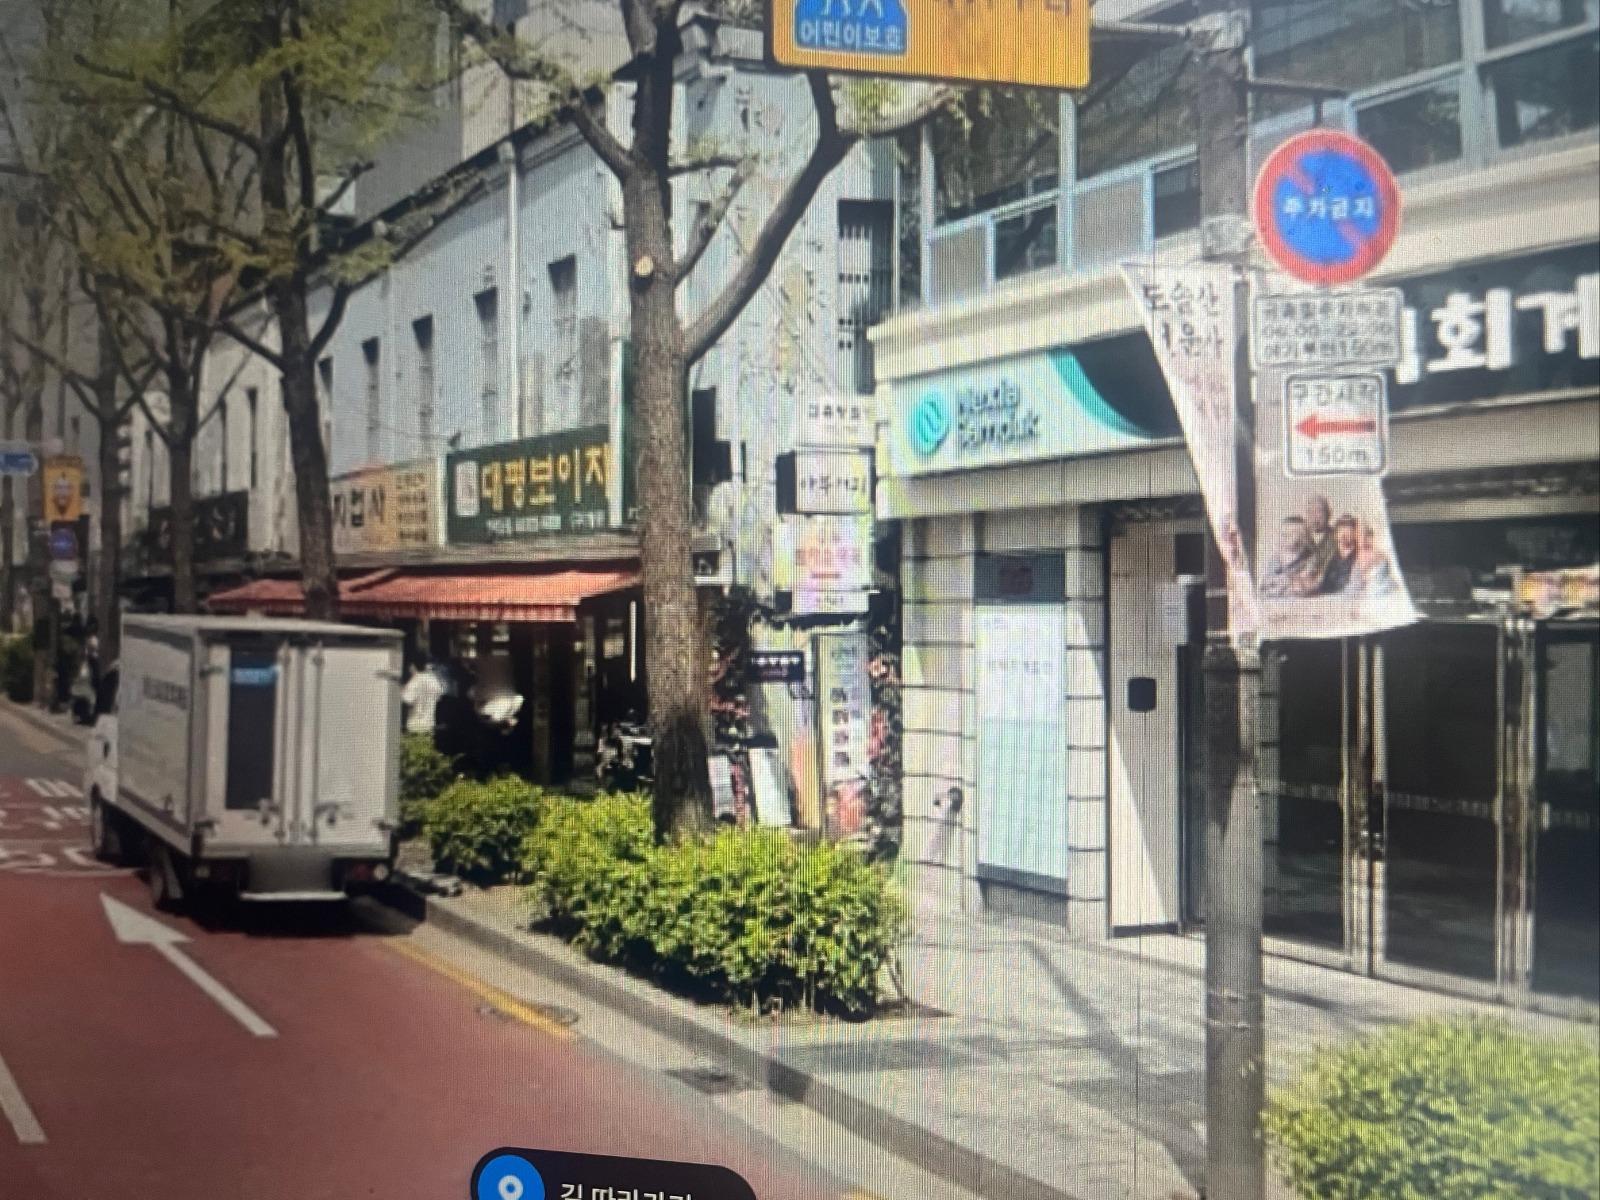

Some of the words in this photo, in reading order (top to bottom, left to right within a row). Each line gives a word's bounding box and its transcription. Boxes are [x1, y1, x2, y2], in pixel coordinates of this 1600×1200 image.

[799, 18, 903, 50] 어린이보호
[1282, 195, 1375, 221] 주차금지
[1293, 383, 1377, 406] 구간시작
[1305, 446, 1368, 464] 150m
